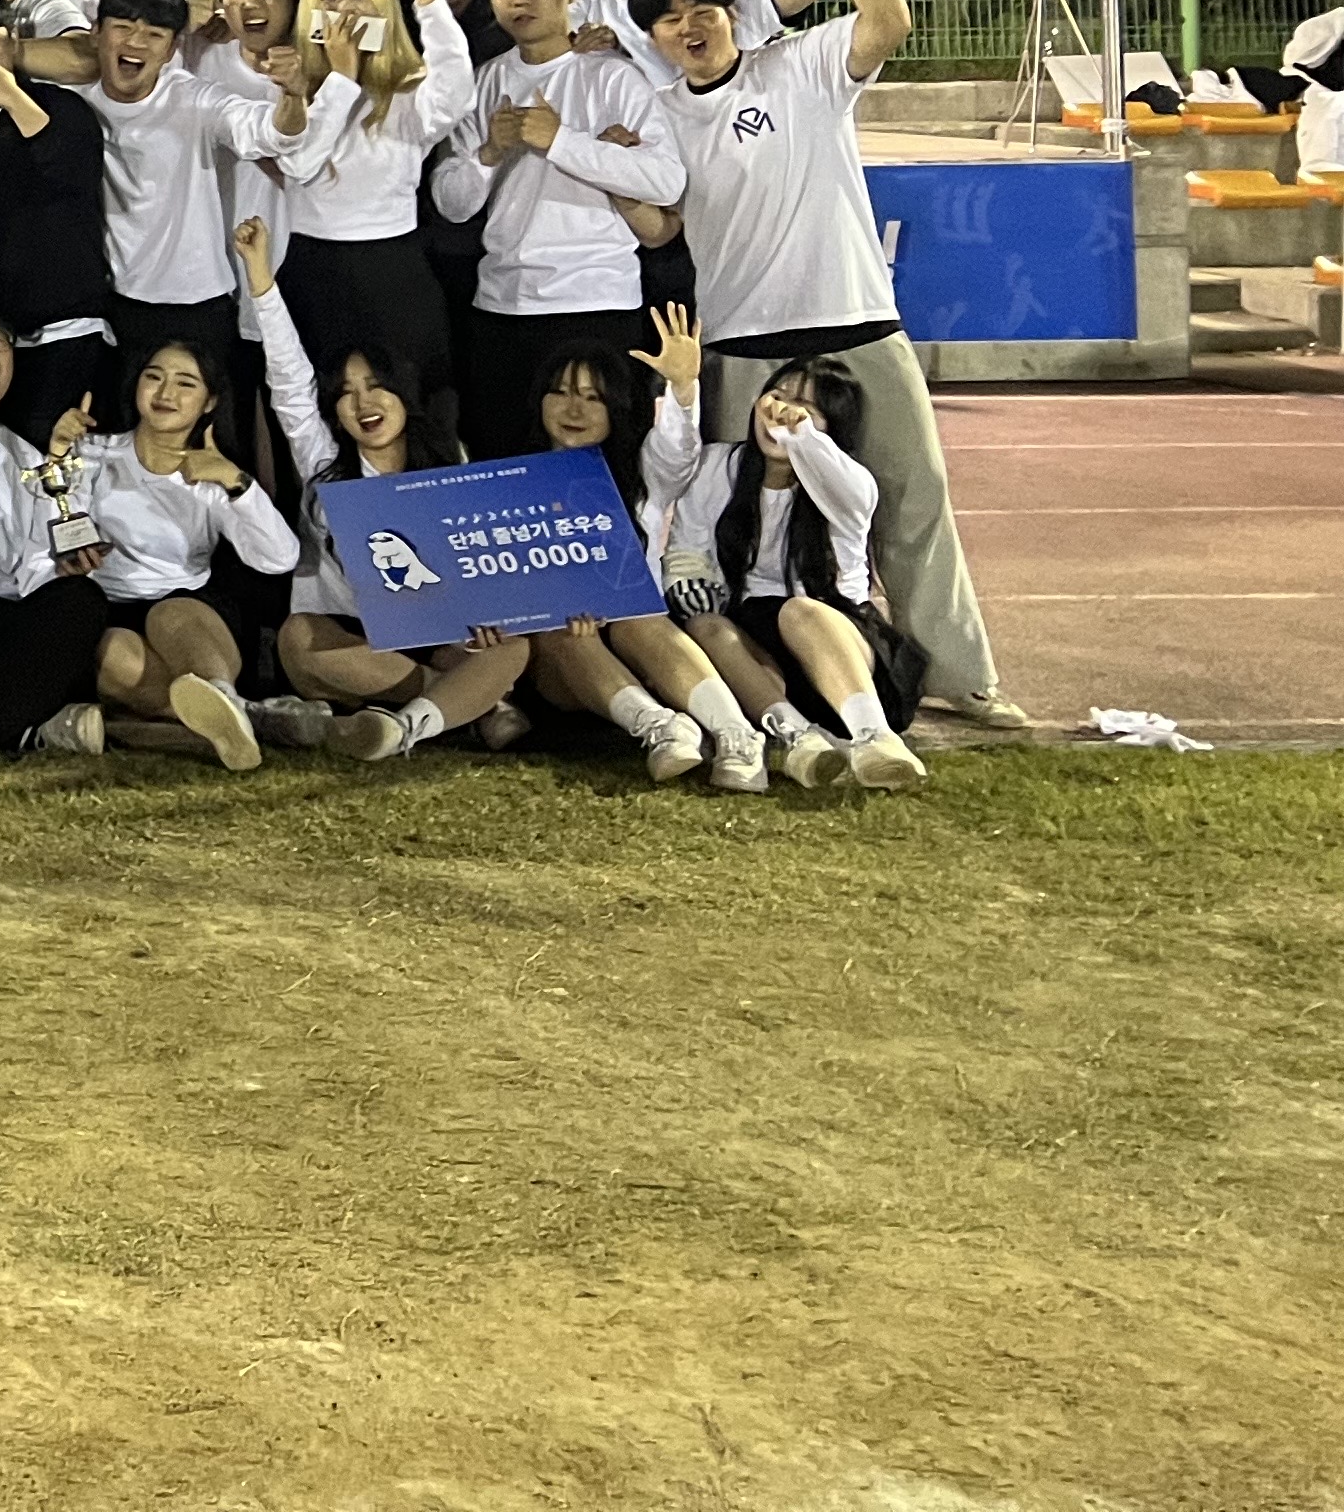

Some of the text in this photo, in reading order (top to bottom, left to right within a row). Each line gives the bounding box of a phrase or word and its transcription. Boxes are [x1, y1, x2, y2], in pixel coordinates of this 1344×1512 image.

[447, 528, 489, 551] 단체
[554, 513, 613, 537] 준우승
[457, 541, 609, 579] 300,000원
